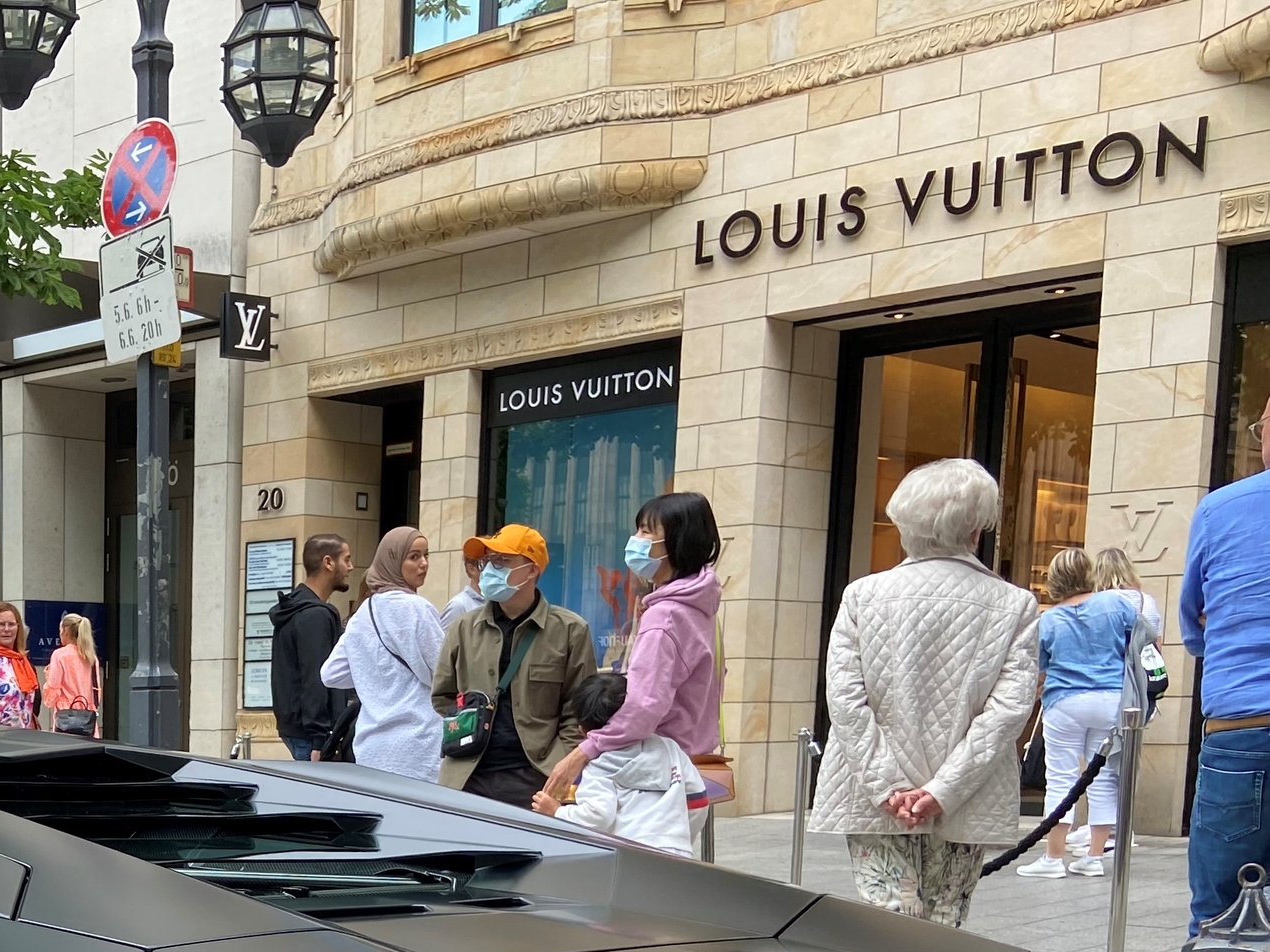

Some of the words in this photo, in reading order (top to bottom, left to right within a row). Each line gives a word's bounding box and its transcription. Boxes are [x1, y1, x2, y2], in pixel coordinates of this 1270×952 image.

[695, 186, 867, 265] LOUIS
[895, 116, 1209, 226] VUITTON
[119, 327, 138, 350] 6.6.
[500, 383, 563, 412] LOUIS
[571, 365, 674, 401] VUITTON
[257, 487, 285, 511] 20
